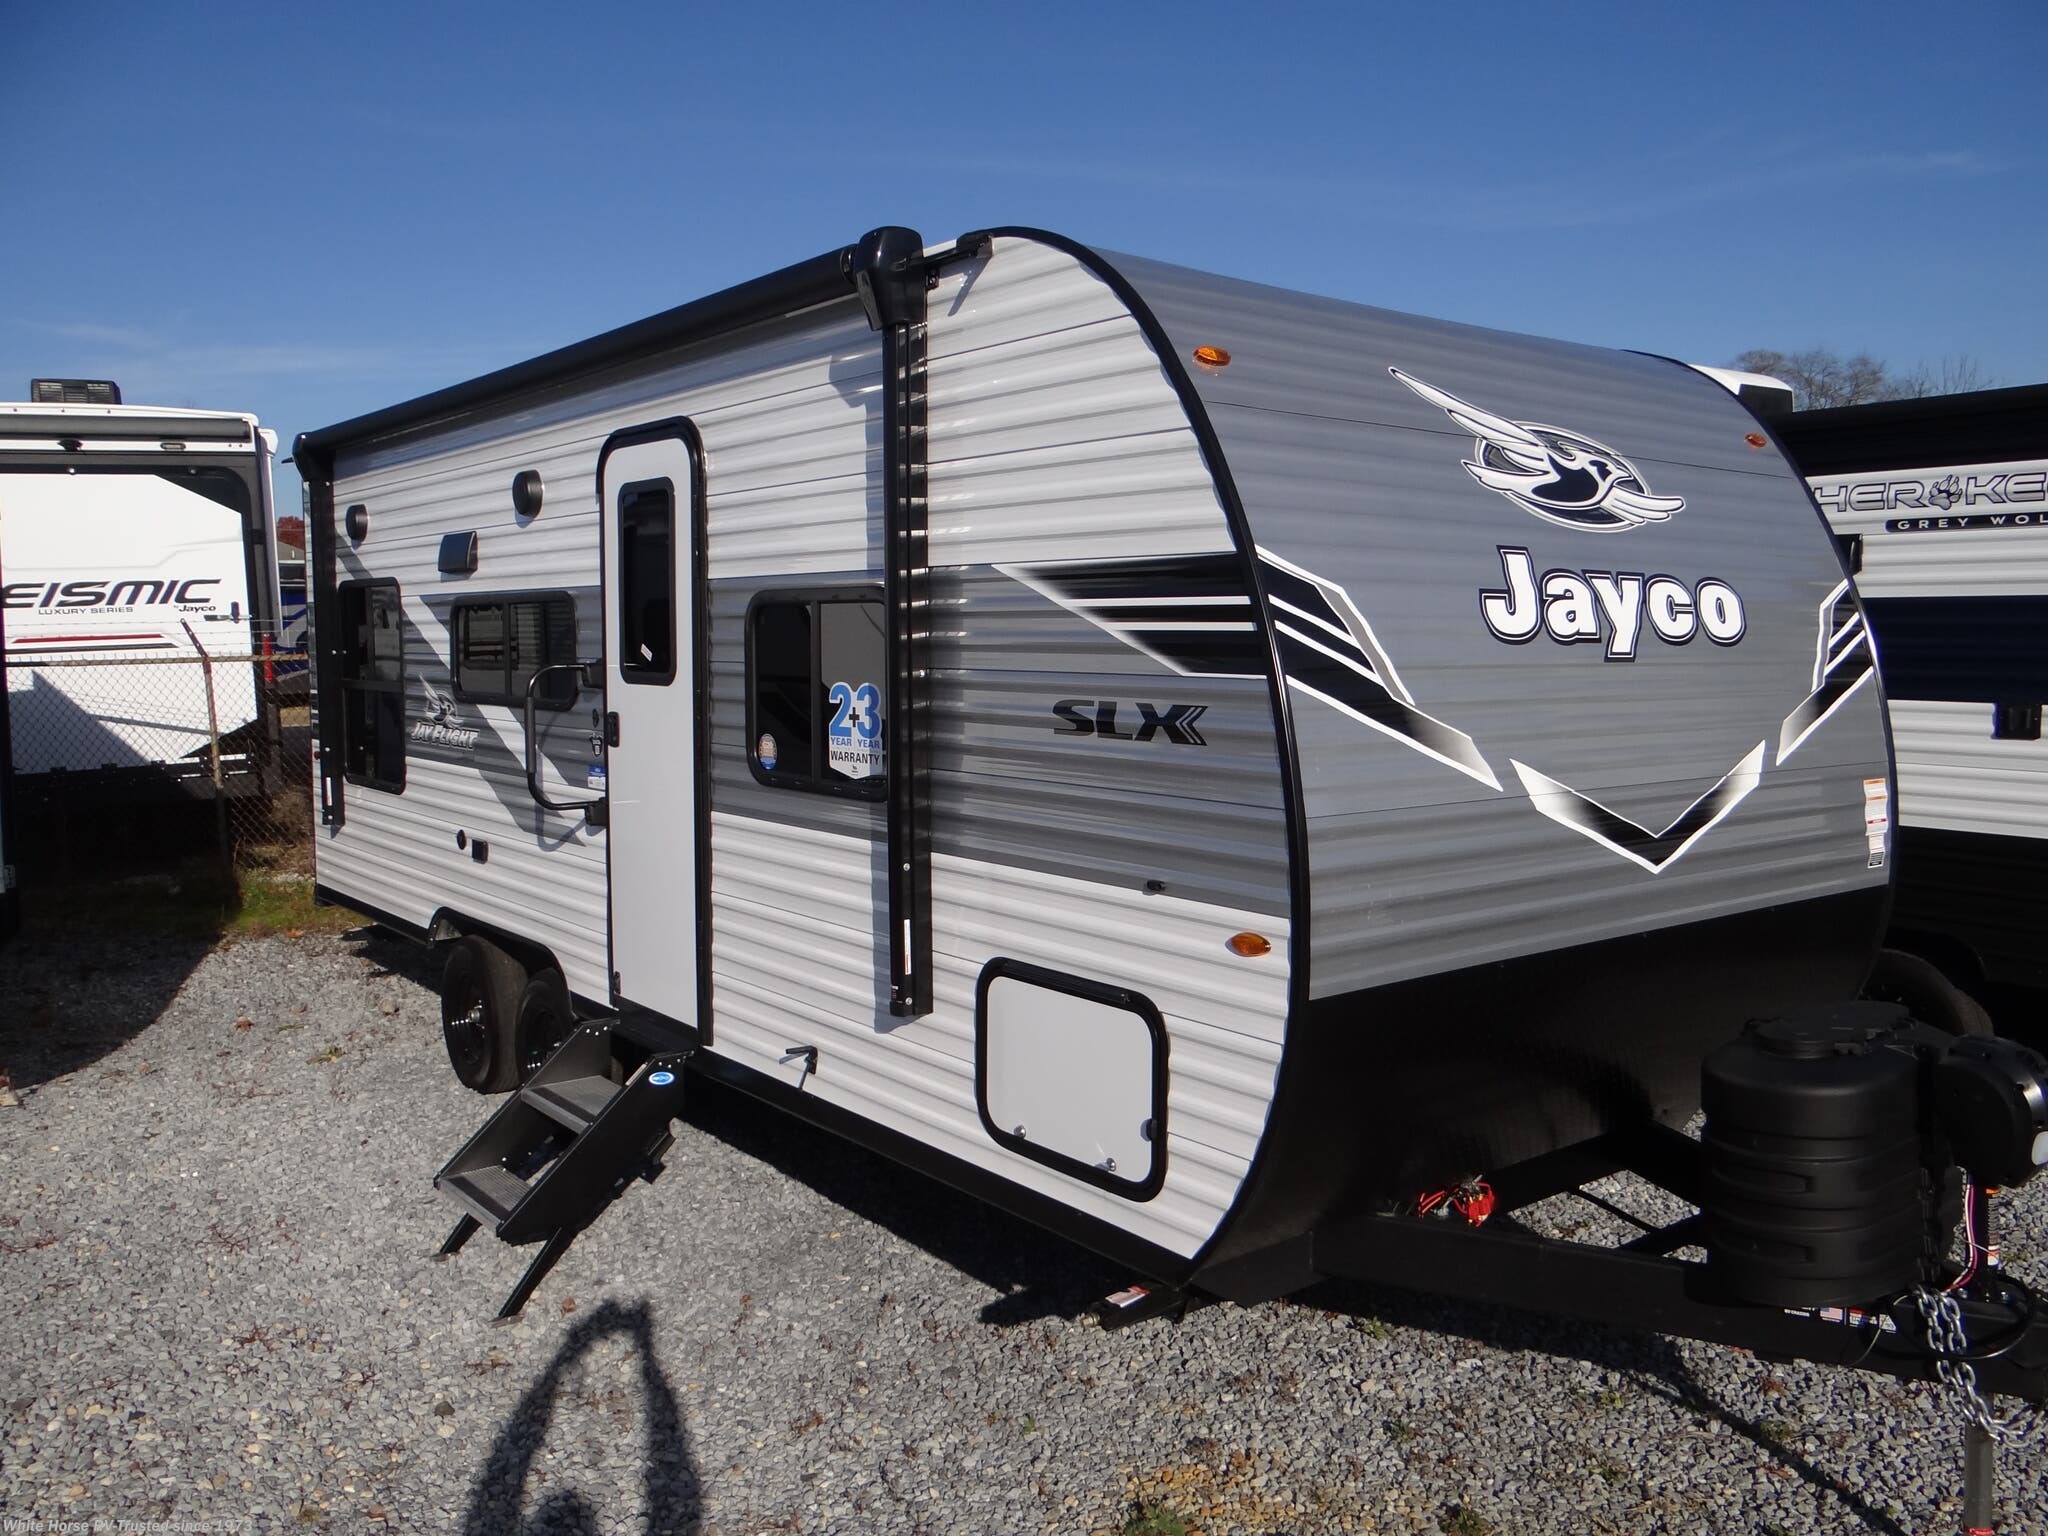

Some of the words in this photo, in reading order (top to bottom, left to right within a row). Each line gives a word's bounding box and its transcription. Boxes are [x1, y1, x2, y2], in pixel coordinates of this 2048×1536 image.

[1897, 518, 1968, 530] GREY
[38, 607, 87, 615] LUXURY
[91, 606, 134, 614] SERIES
[178, 604, 217, 613] Jayco
[1479, 545, 1747, 663] Jayco
[1052, 699, 1209, 746] SLX
[410, 720, 434, 742] JAY
[431, 724, 479, 750] FLIGHT
[830, 736, 852, 747] YEAR
[857, 738, 880, 749] YEAR
[830, 750, 880, 765] WARRANTY
